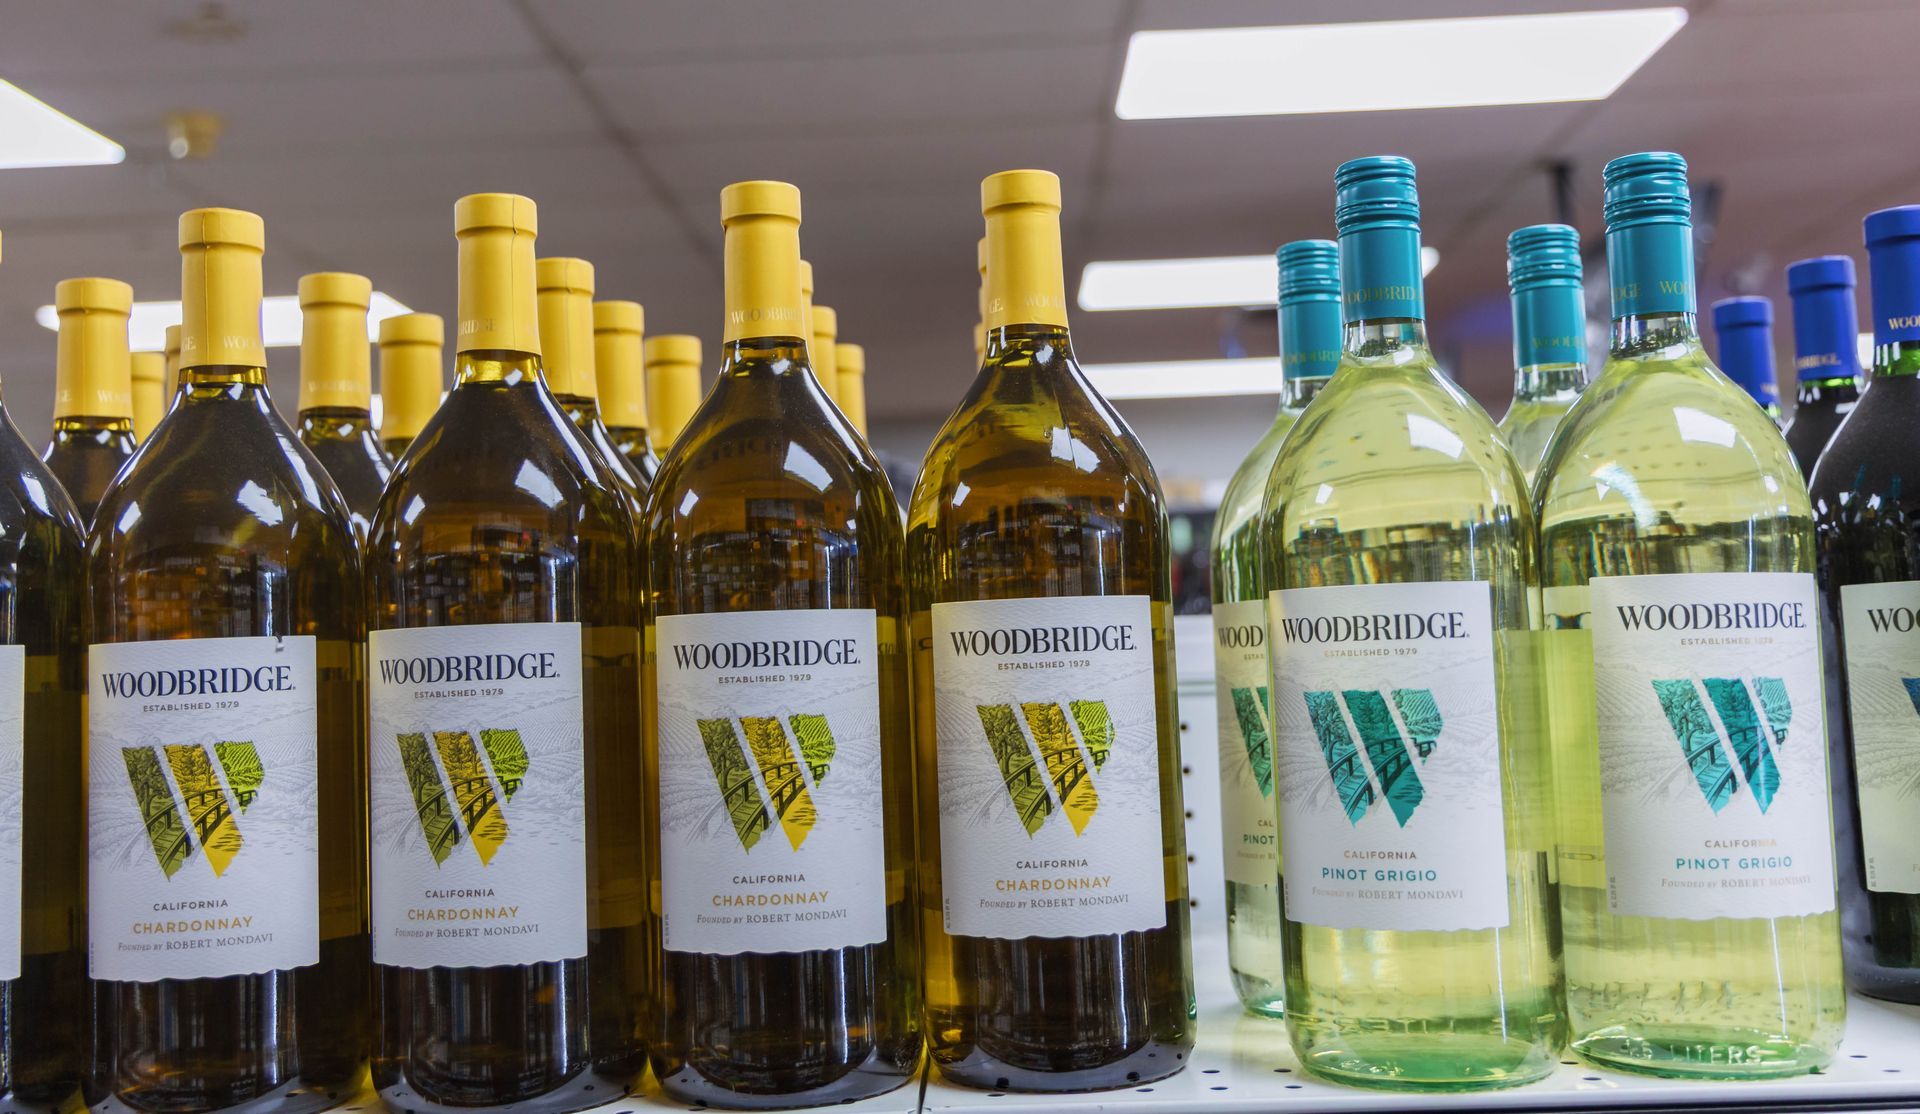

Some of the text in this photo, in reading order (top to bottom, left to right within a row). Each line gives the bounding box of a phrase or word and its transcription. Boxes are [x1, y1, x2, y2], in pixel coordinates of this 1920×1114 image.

[1867, 607, 1920, 633] WO
[1681, 637, 1749, 646] ESTABLISHED
[1324, 648, 1390, 657] ESTABLISHED
[998, 659, 1091, 670] ESTABLISHED 1979
[719, 673, 812, 684] ESTABLISHED 1979
[415, 687, 504, 699] ESTABLISHED 1979
[143, 700, 240, 713] ESTABLISHED 1979
[1243, 833, 1275, 845] PINOT
[1704, 838, 1777, 849] CALIFORNIA
[1343, 850, 1417, 860] CALIFORNIA
[1016, 858, 1089, 869] CALIFORNIA
[1676, 855, 1793, 870] PINOT GRIGIO
[733, 873, 806, 884] CALIFORNIA
[1322, 867, 1437, 882] PINOT GRIGIO
[995, 875, 1112, 891] CHARDONNAY
[1721, 877, 1766, 889] ROBERT
[425, 888, 495, 899] CALIFORNIA
[712, 890, 829, 907] CHARDONNAY
[1358, 889, 1404, 900] ROBERT
[1407, 889, 1464, 900] MONDAVI
[153, 899, 229, 912] CALIFORNIA
[1030, 897, 1076, 909] ROBERT
[1079, 893, 1129, 907] MONDAVI
[408, 905, 519, 921] CHARDONNAY
[746, 913, 792, 924] ROBERT
[795, 908, 847, 922] MONDAVI
[133, 915, 253, 934] CHARDONNAY
[437, 927, 481, 938] ROBERT
[483, 923, 539, 937] MONDAVI
[166, 938, 212, 951] ROBERT
[216, 933, 273, 947] MONDAVI
